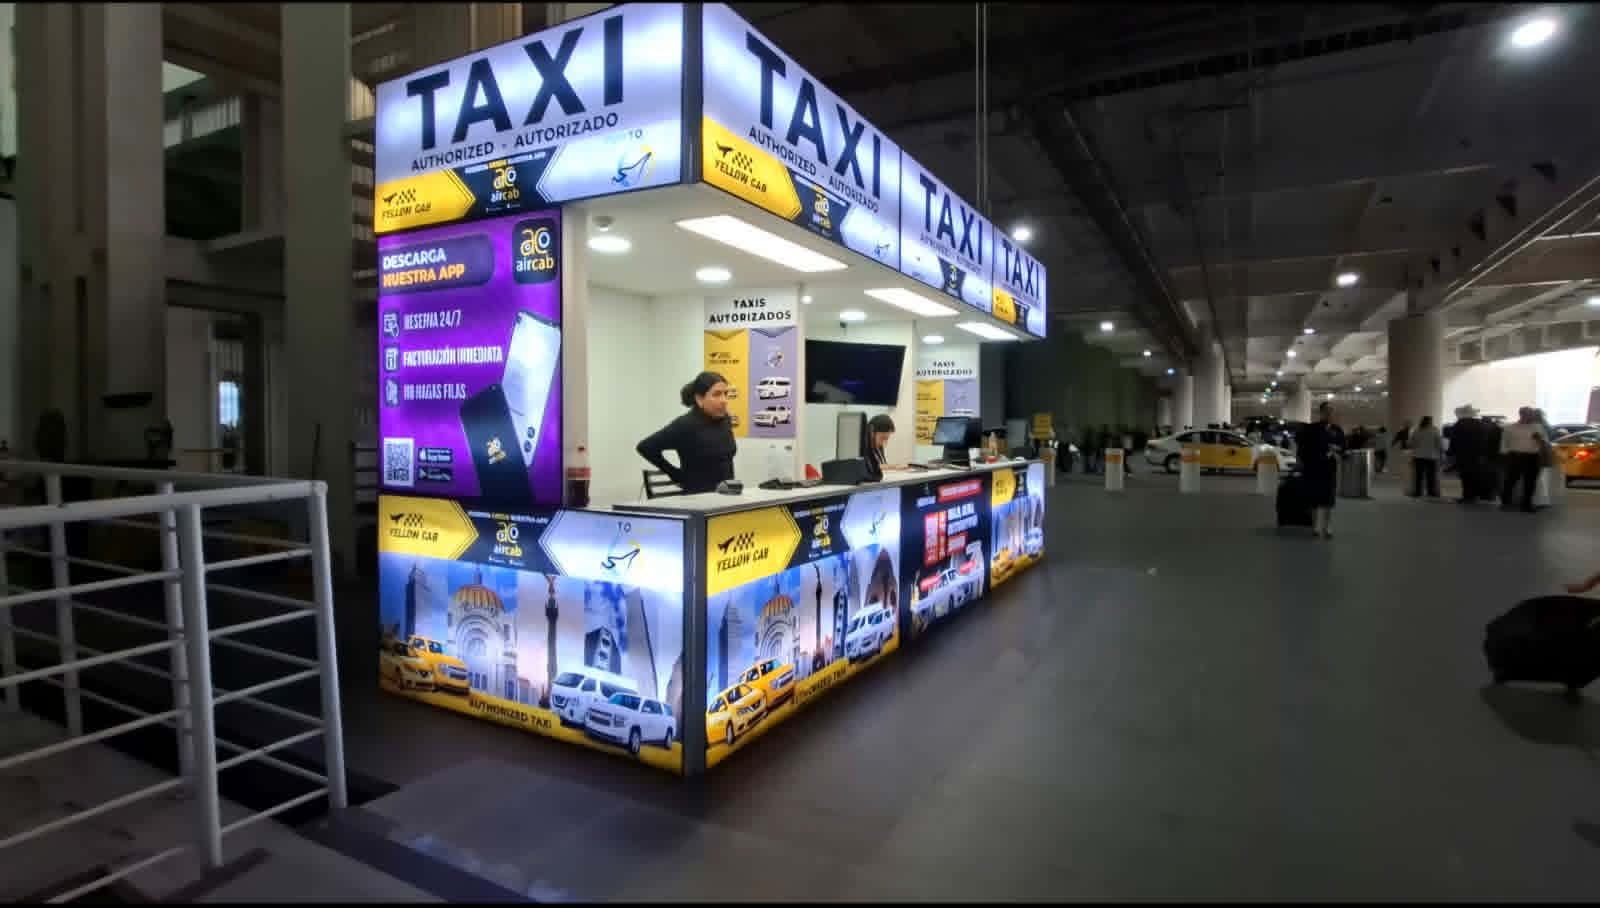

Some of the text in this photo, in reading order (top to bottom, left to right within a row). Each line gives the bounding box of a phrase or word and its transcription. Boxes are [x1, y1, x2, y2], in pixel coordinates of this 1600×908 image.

[407, 15, 623, 151] TAXI
[746, 30, 881, 201] TAXI
[411, 141, 495, 172] AUTHORIZED
[514, 111, 619, 149] AUTORIZADO
[714, 159, 749, 187] YELLOW
[750, 174, 767, 193] CAB
[748, 125, 817, 177] AUTHORIZED
[828, 174, 879, 214] AUTORIZADO
[491, 188, 520, 203] aircab
[382, 203, 432, 219] YELLOW CAB
[920, 171, 983, 265] TAXI
[382, 246, 447, 269] DESCARGA
[515, 253, 554, 273] aircab
[1002, 237, 1040, 301] TAXI
[383, 262, 465, 288] NUESTRA APP
[732, 297, 767, 309] TAXIS
[439, 309, 463, 328] 24/7
[709, 310, 792, 324] AUTORIZADOS
[443, 383, 467, 400] FILAS
[389, 527, 439, 544] YELLOW CAB
[493, 543, 523, 558] aircab
[717, 547, 770, 574] YELLOW CAB
[469, 697, 553, 729] AUTHORIZED TAXI
